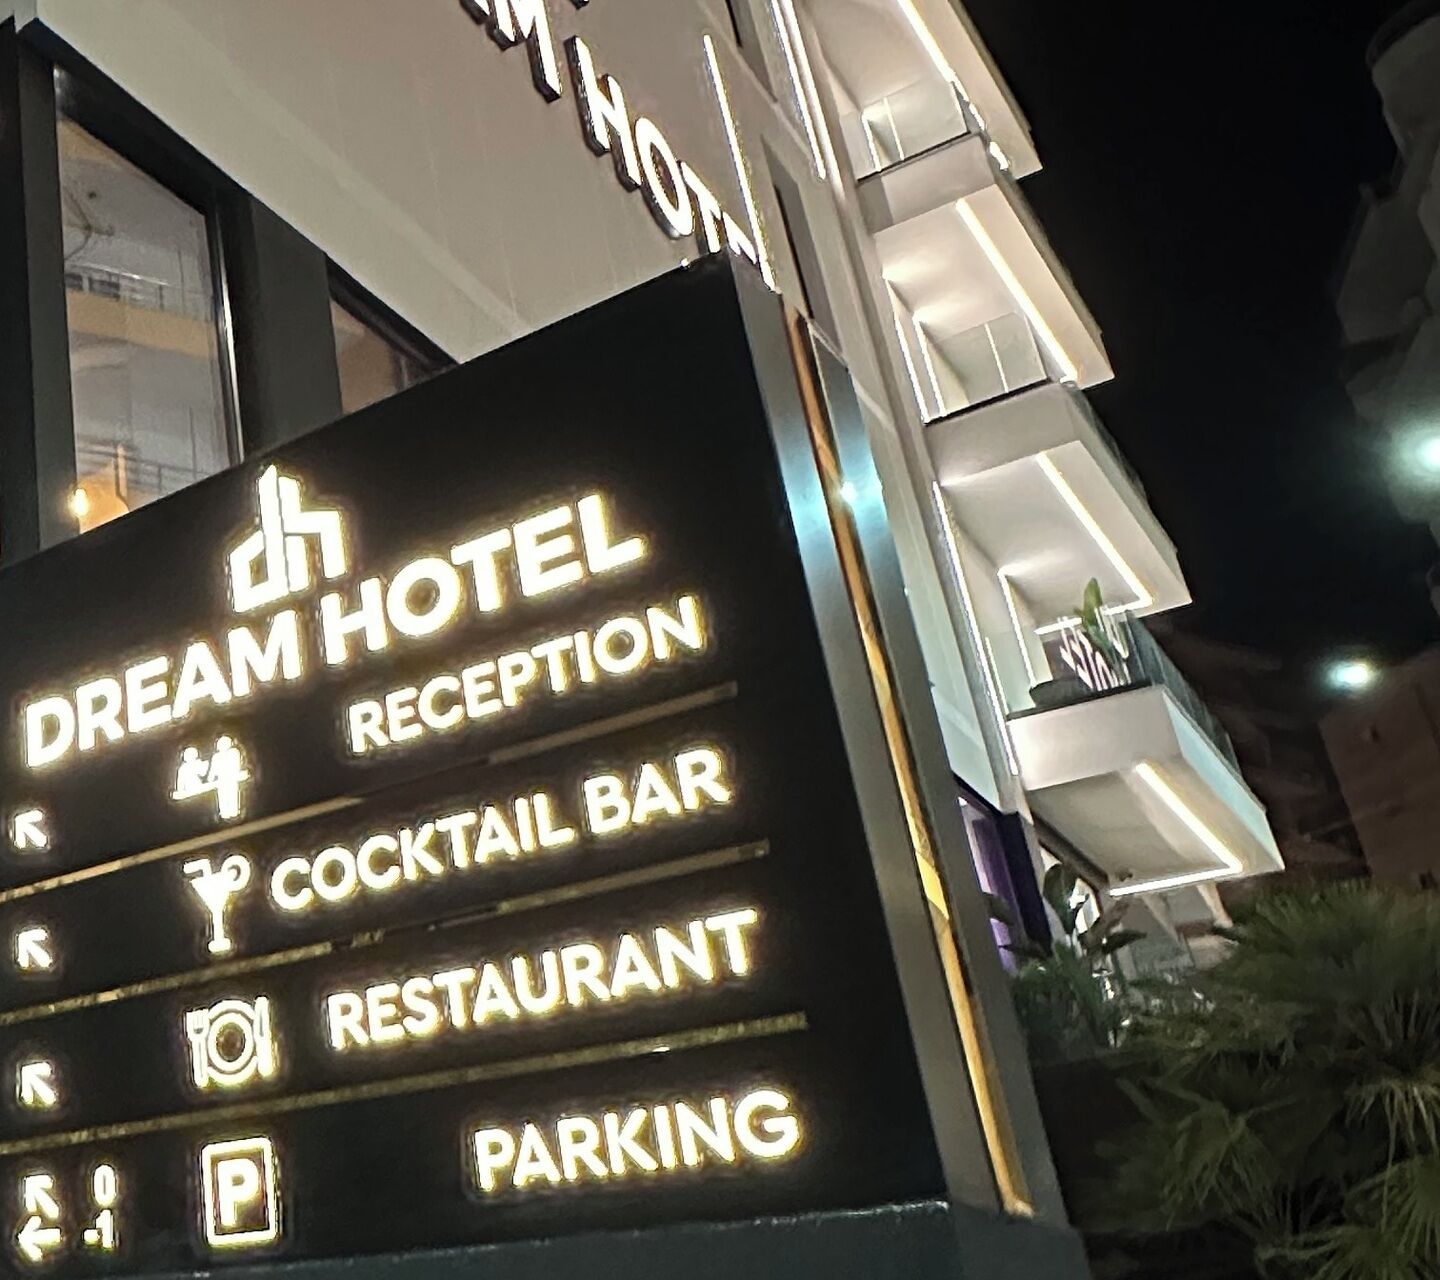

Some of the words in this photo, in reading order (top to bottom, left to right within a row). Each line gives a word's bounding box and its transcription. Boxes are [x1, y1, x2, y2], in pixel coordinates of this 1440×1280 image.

[564, 35, 760, 266] HOT
[22, 608, 305, 771] DREAM
[319, 493, 647, 665] HOTEL
[348, 595, 704, 754] RECEPTION
[270, 791, 576, 911] COCKTAIL
[582, 748, 732, 836] BAR
[327, 908, 758, 1051] RESTAURANT
[216, 1158, 260, 1226] P
[474, 1089, 801, 1193] PARKING
